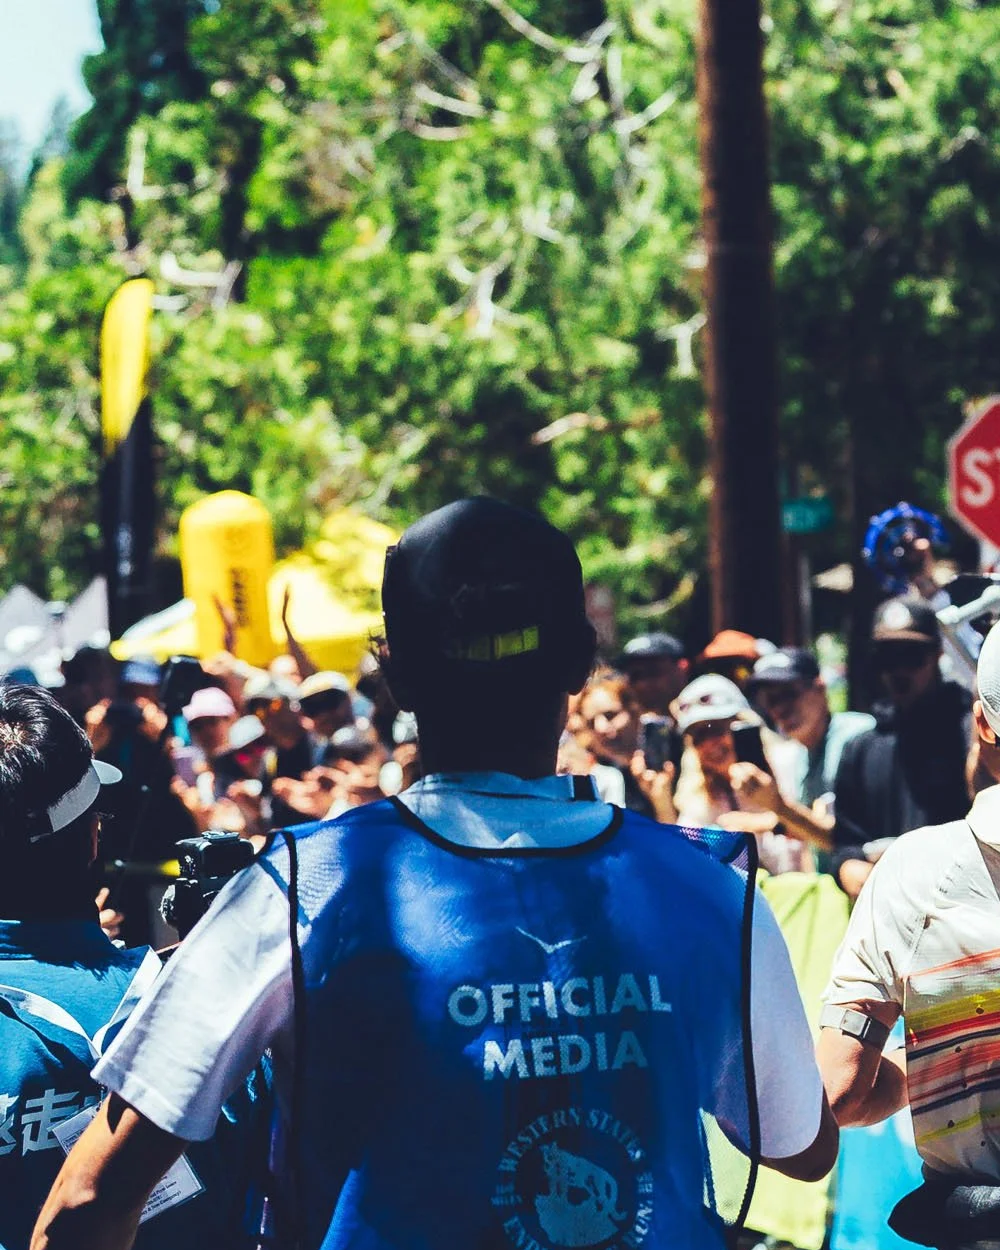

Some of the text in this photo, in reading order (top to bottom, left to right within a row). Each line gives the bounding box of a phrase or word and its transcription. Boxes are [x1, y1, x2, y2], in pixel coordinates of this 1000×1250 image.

[447, 973, 672, 1026] OFFICIAL
[483, 1031, 647, 1080] MEDIA
[498, 1106, 645, 1172] WESTERN STATES
